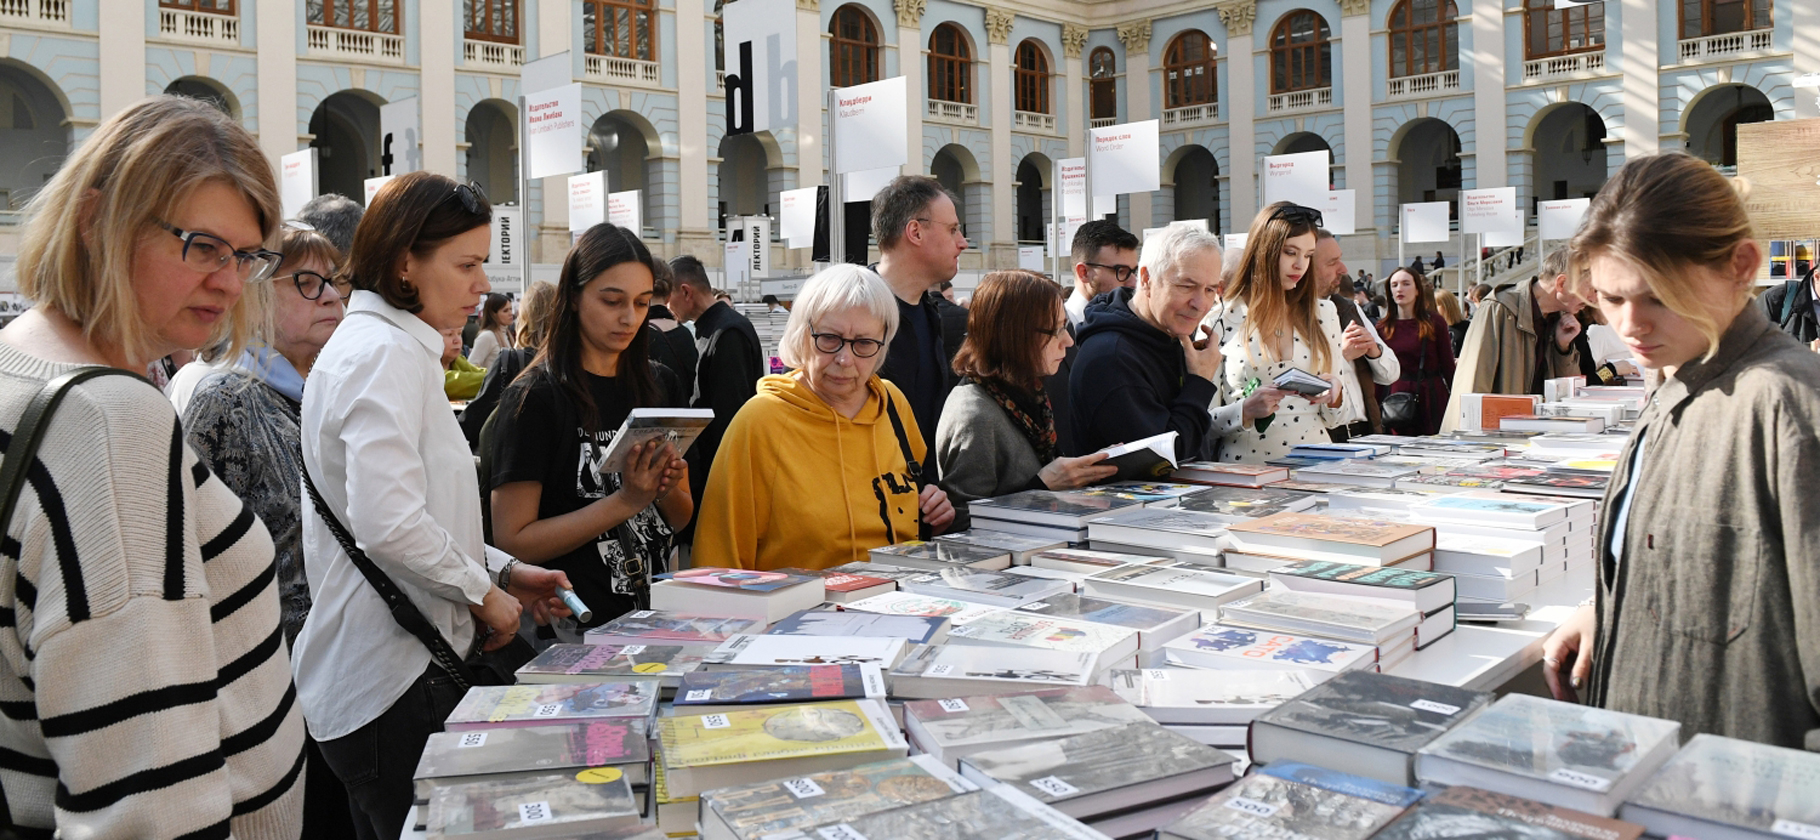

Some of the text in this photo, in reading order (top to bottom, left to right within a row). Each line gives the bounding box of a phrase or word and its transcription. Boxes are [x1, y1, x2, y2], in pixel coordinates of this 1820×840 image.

[529, 100, 559, 112] Издательство
[839, 96, 872, 107] Клаудберри
[1110, 143, 1125, 151] Order
[750, 225, 762, 272] ЛЕКТОРИЙ
[541, 704, 557, 715] 550
[706, 714, 723, 727] 550
[464, 733, 482, 746] 550
[1036, 780, 1068, 794] 550
[524, 803, 544, 819] 300
[1231, 800, 1271, 814] 500
